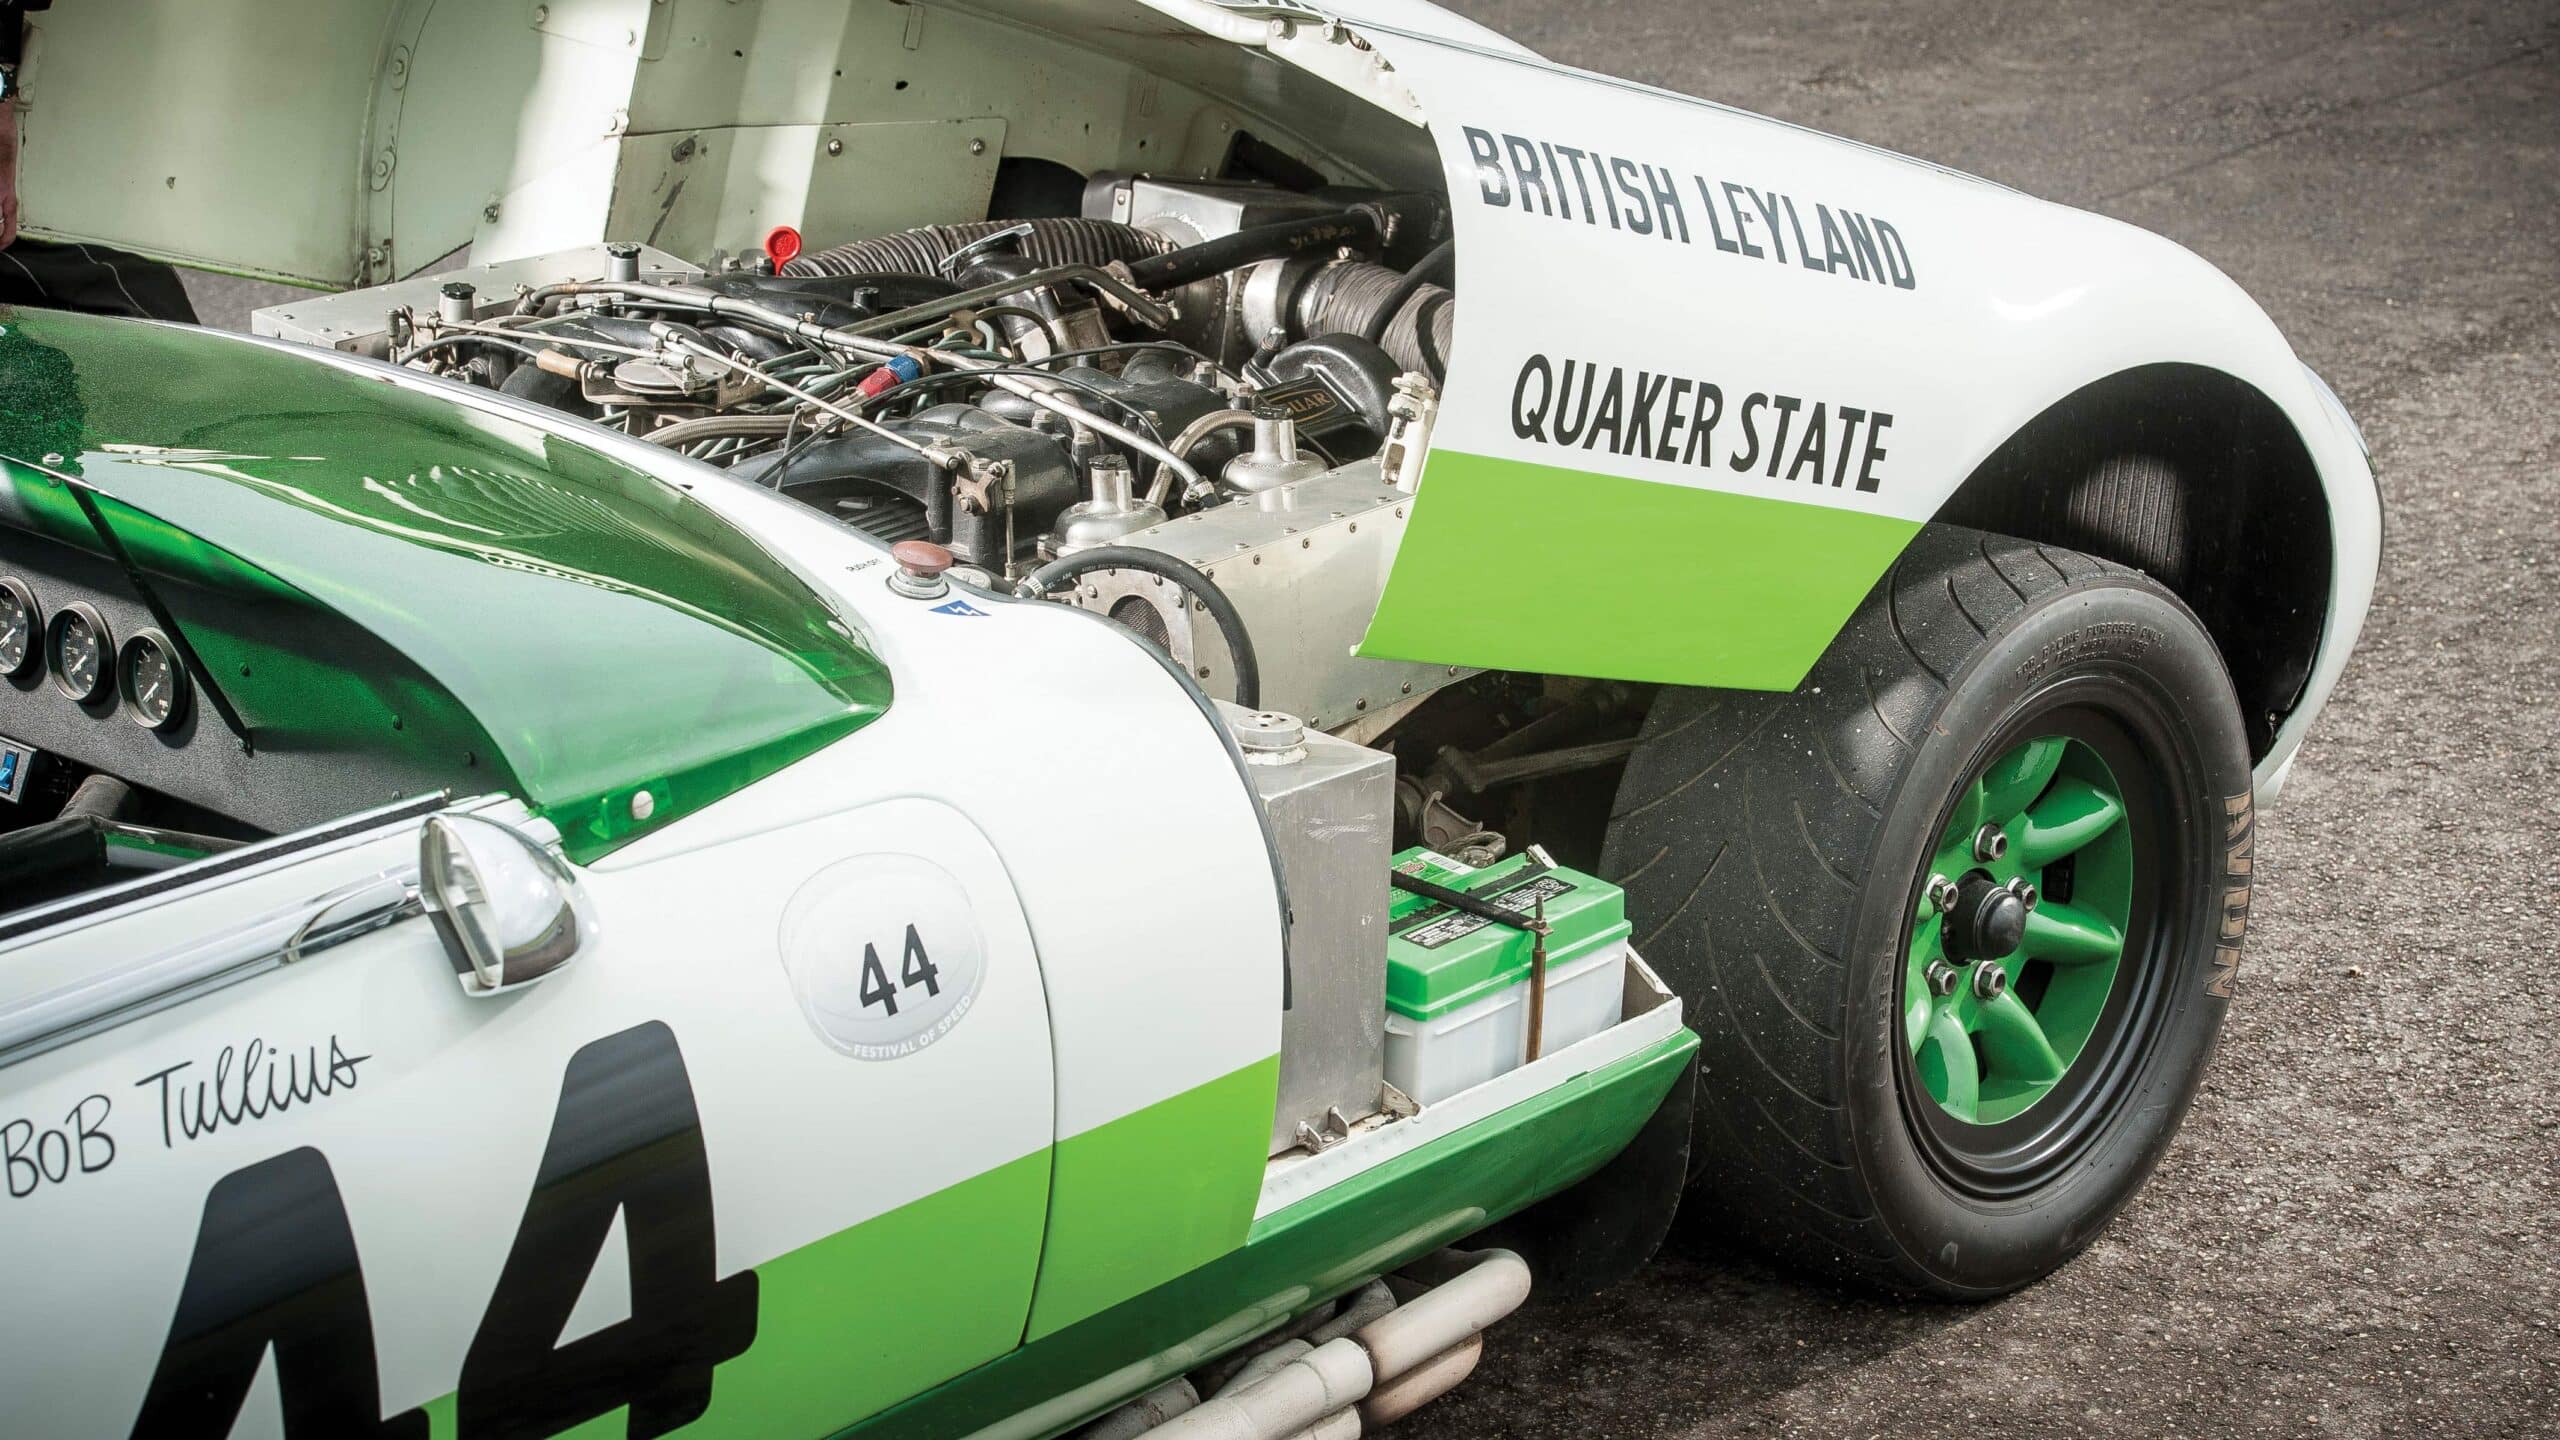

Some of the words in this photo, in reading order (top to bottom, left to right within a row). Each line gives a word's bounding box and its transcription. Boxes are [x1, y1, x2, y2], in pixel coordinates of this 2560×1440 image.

[1461, 125, 1690, 244] BRITISH
[1694, 174, 1917, 291] LEYLAND
[1511, 353, 1724, 468] QUAKER
[1728, 392, 1894, 494] STATE
[2015, 655, 2036, 680] FOR
[2085, 621, 2137, 639] PURPOSES
[2140, 625, 2166, 645] ONLY
[853, 1042, 916, 1059] FESTIVAL
[919, 1031, 937, 1046] OF
[938, 994, 972, 1034] SPEED
[859, 922, 940, 1018] 44
[134, 1034, 373, 1149] Tullius
[127, 1020, 760, 1440] 44
